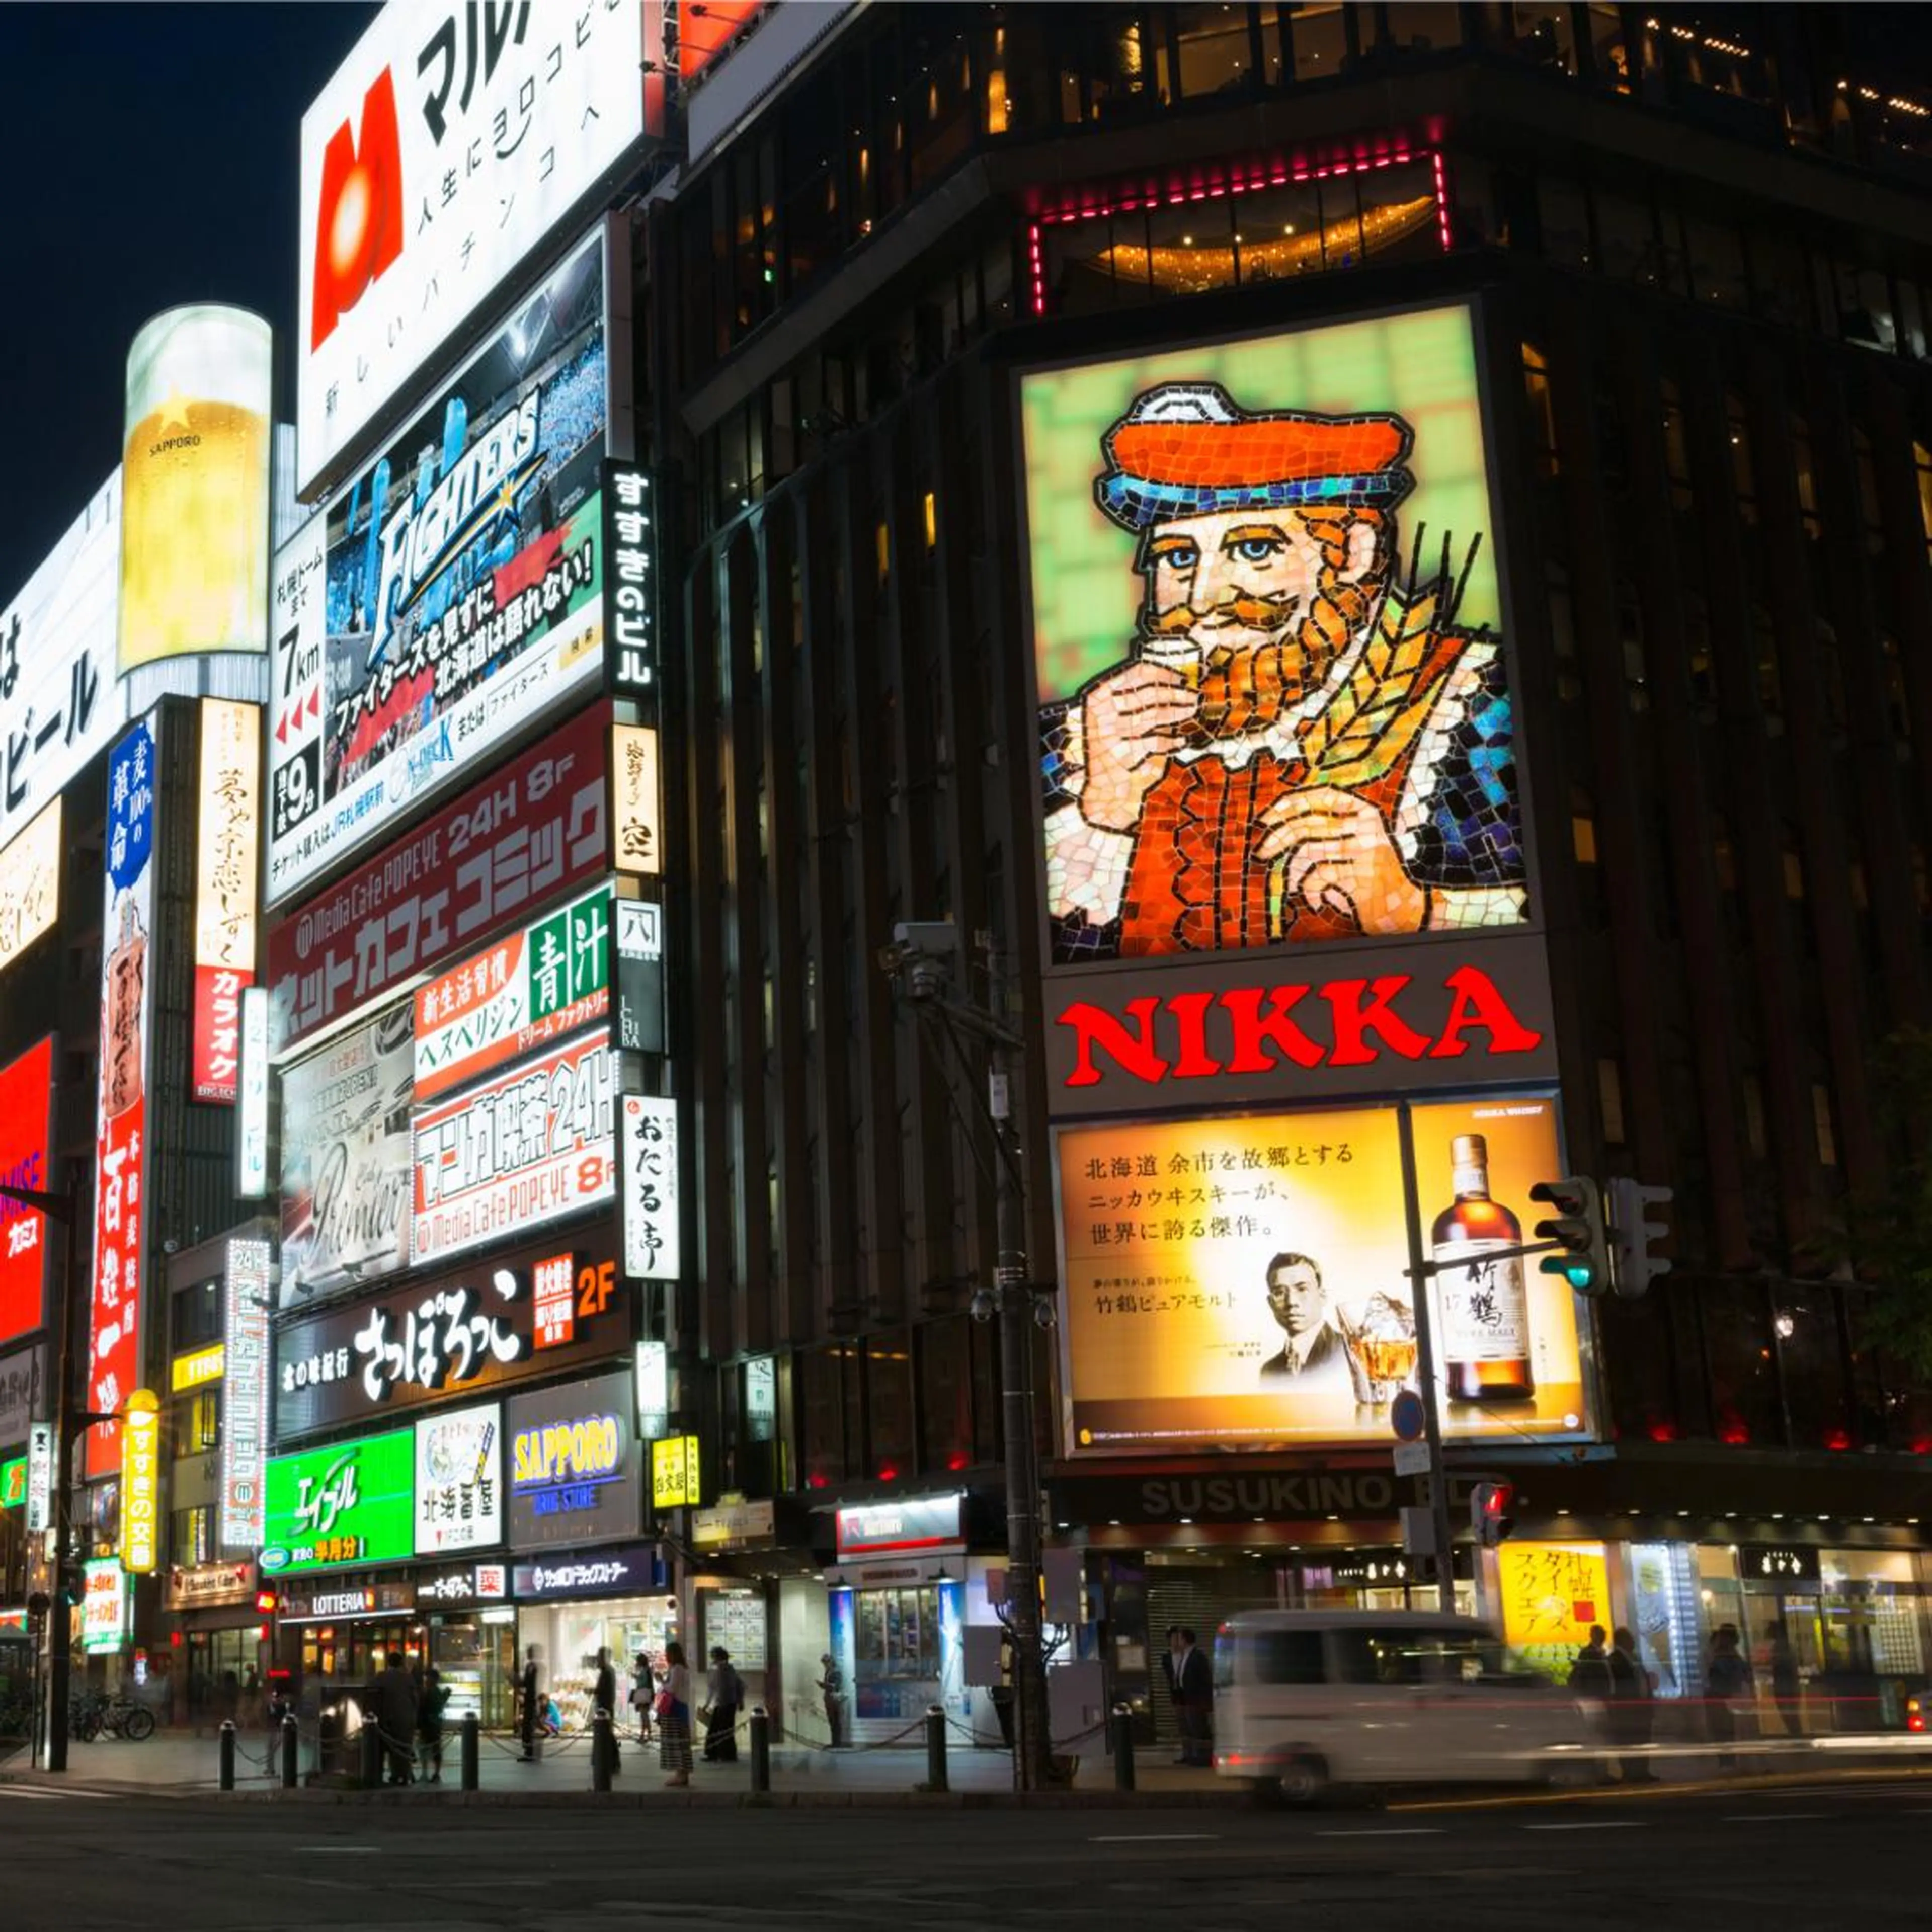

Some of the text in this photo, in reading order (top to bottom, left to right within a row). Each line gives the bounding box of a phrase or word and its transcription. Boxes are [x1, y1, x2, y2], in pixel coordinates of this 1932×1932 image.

[149, 434, 201, 457] SAPPORO
[613, 472, 652, 684] すすきのビル
[279, 624, 320, 698] 7km
[313, 893, 350, 939] Media
[352, 873, 383, 922] Cafe
[383, 828, 442, 896] POPEYE
[448, 781, 516, 857] 24H
[526, 754, 575, 802] 8F
[423, 949, 508, 1025] 新生活習慣
[532, 907, 609, 1013] 青汁
[210, 970, 239, 1080] カラオケ
[1055, 964, 1542, 1088] NIKKA
[509, 1164, 570, 1223] POPEYE
[1086, 1143, 1353, 1181] 北海道 余市を故郷とする
[578, 1260, 615, 1318] 2F
[514, 1416, 618, 1482] SAPPORO
[1142, 1473, 1392, 1515] SUSUKINO
[312, 1591, 365, 1615] LOTTERIA
